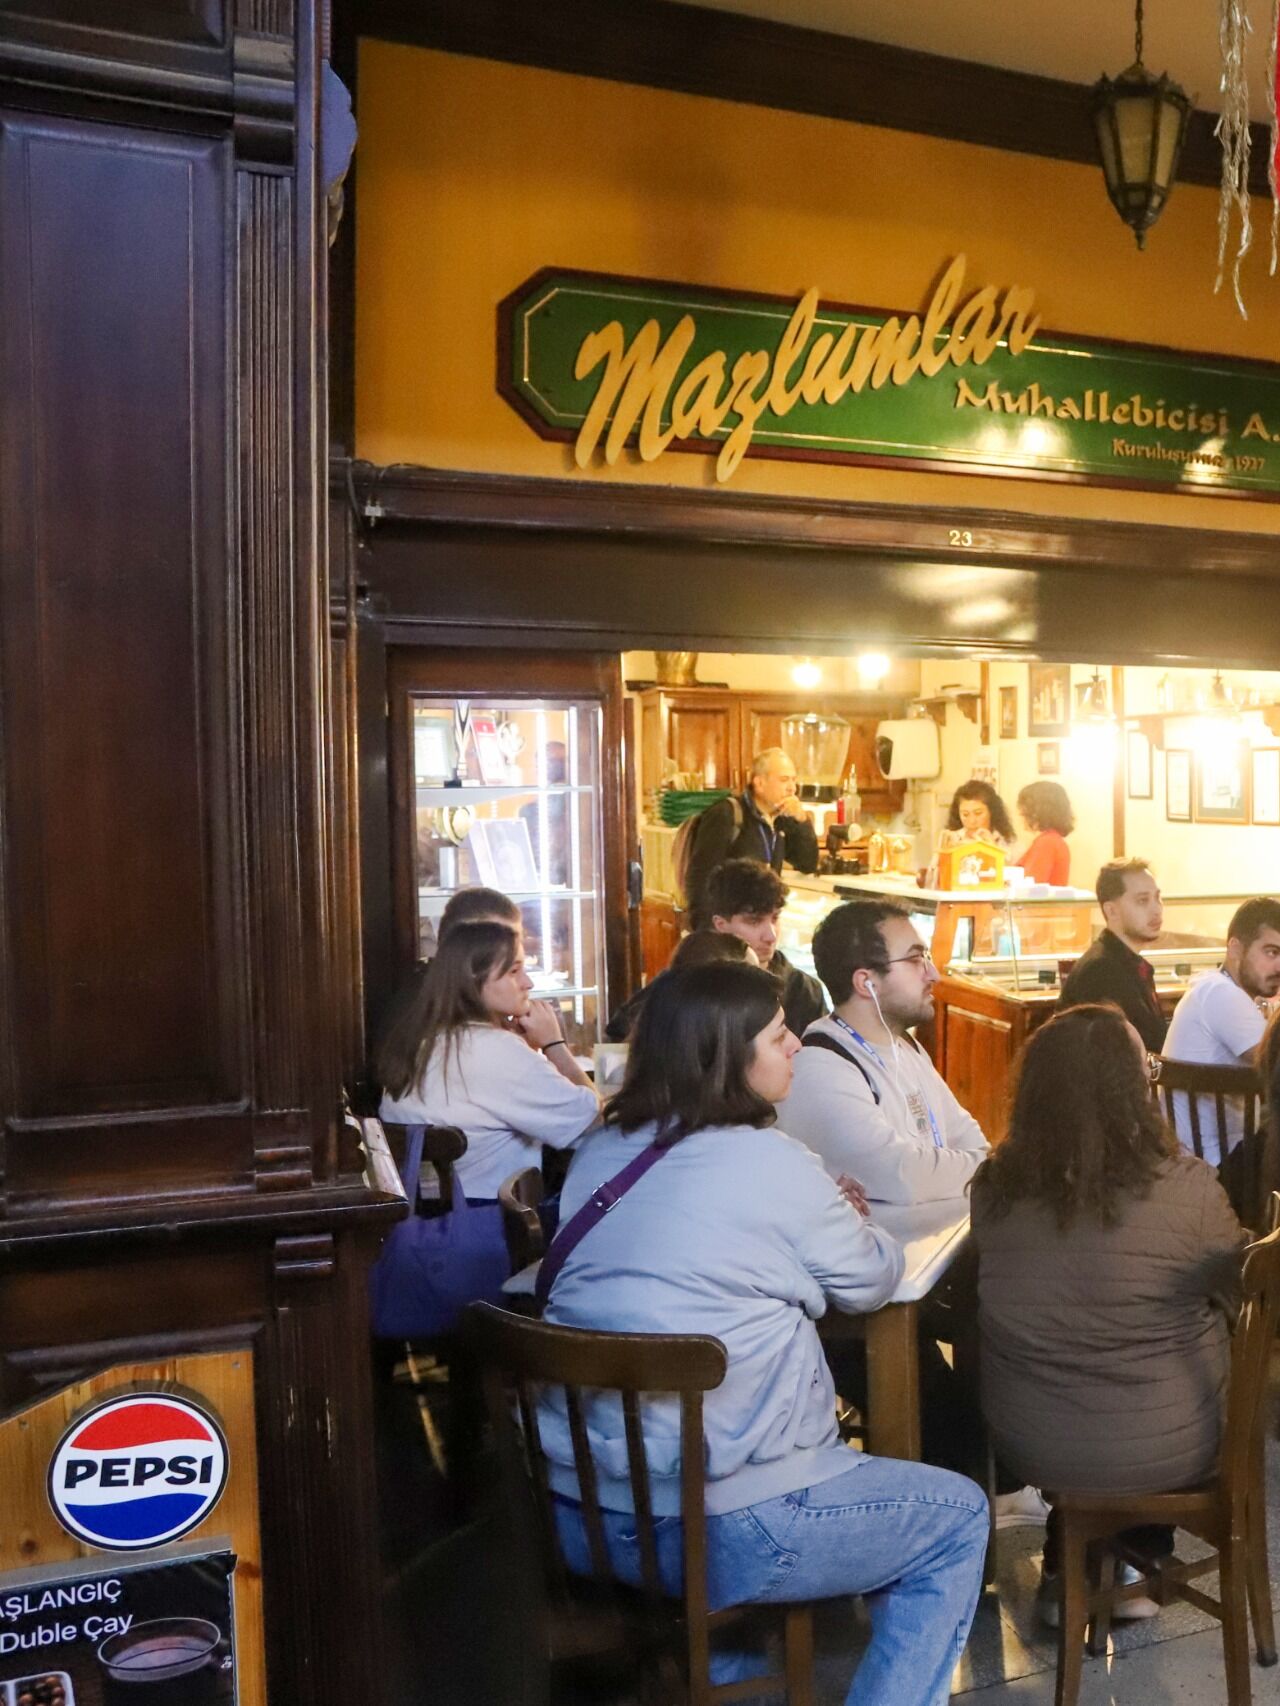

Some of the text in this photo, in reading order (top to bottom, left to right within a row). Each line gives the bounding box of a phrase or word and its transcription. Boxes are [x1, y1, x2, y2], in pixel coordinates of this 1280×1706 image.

[574, 253, 1041, 482] Mazlumlar
[954, 379, 1230, 436] Muhallebicisi
[949, 529, 972, 547] 23
[64, 1454, 214, 1489] PEPSI
[0, 1614, 133, 1654] Duble Çay
